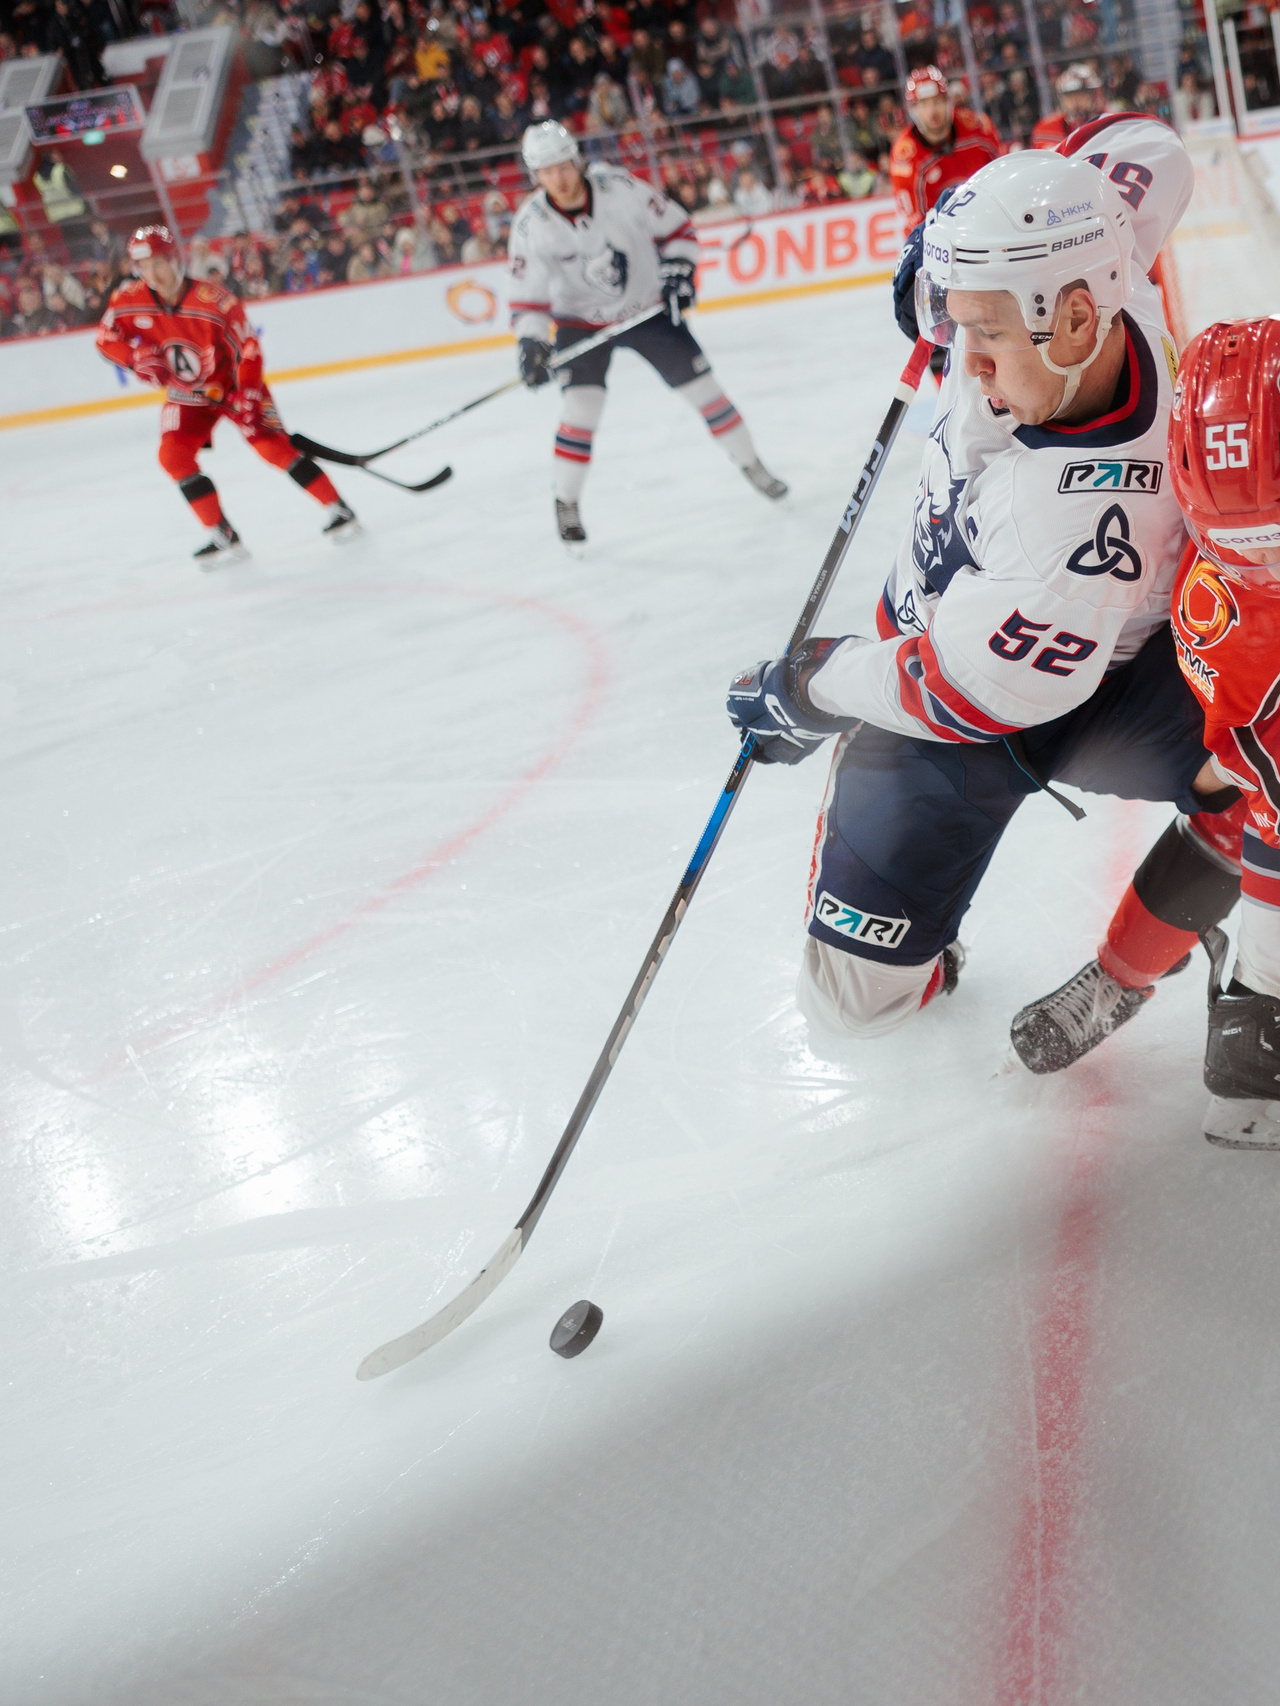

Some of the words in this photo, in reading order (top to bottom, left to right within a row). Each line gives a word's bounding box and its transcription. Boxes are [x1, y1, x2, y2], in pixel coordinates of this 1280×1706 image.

[693, 210, 898, 293] FONBE
[1051, 228, 1105, 253] BAUER
[1205, 422, 1249, 470] 55
[840, 439, 884, 534] CCM
[1063, 462, 1160, 490] PARI
[988, 607, 1098, 677] 52
[818, 896, 905, 944] PARI
